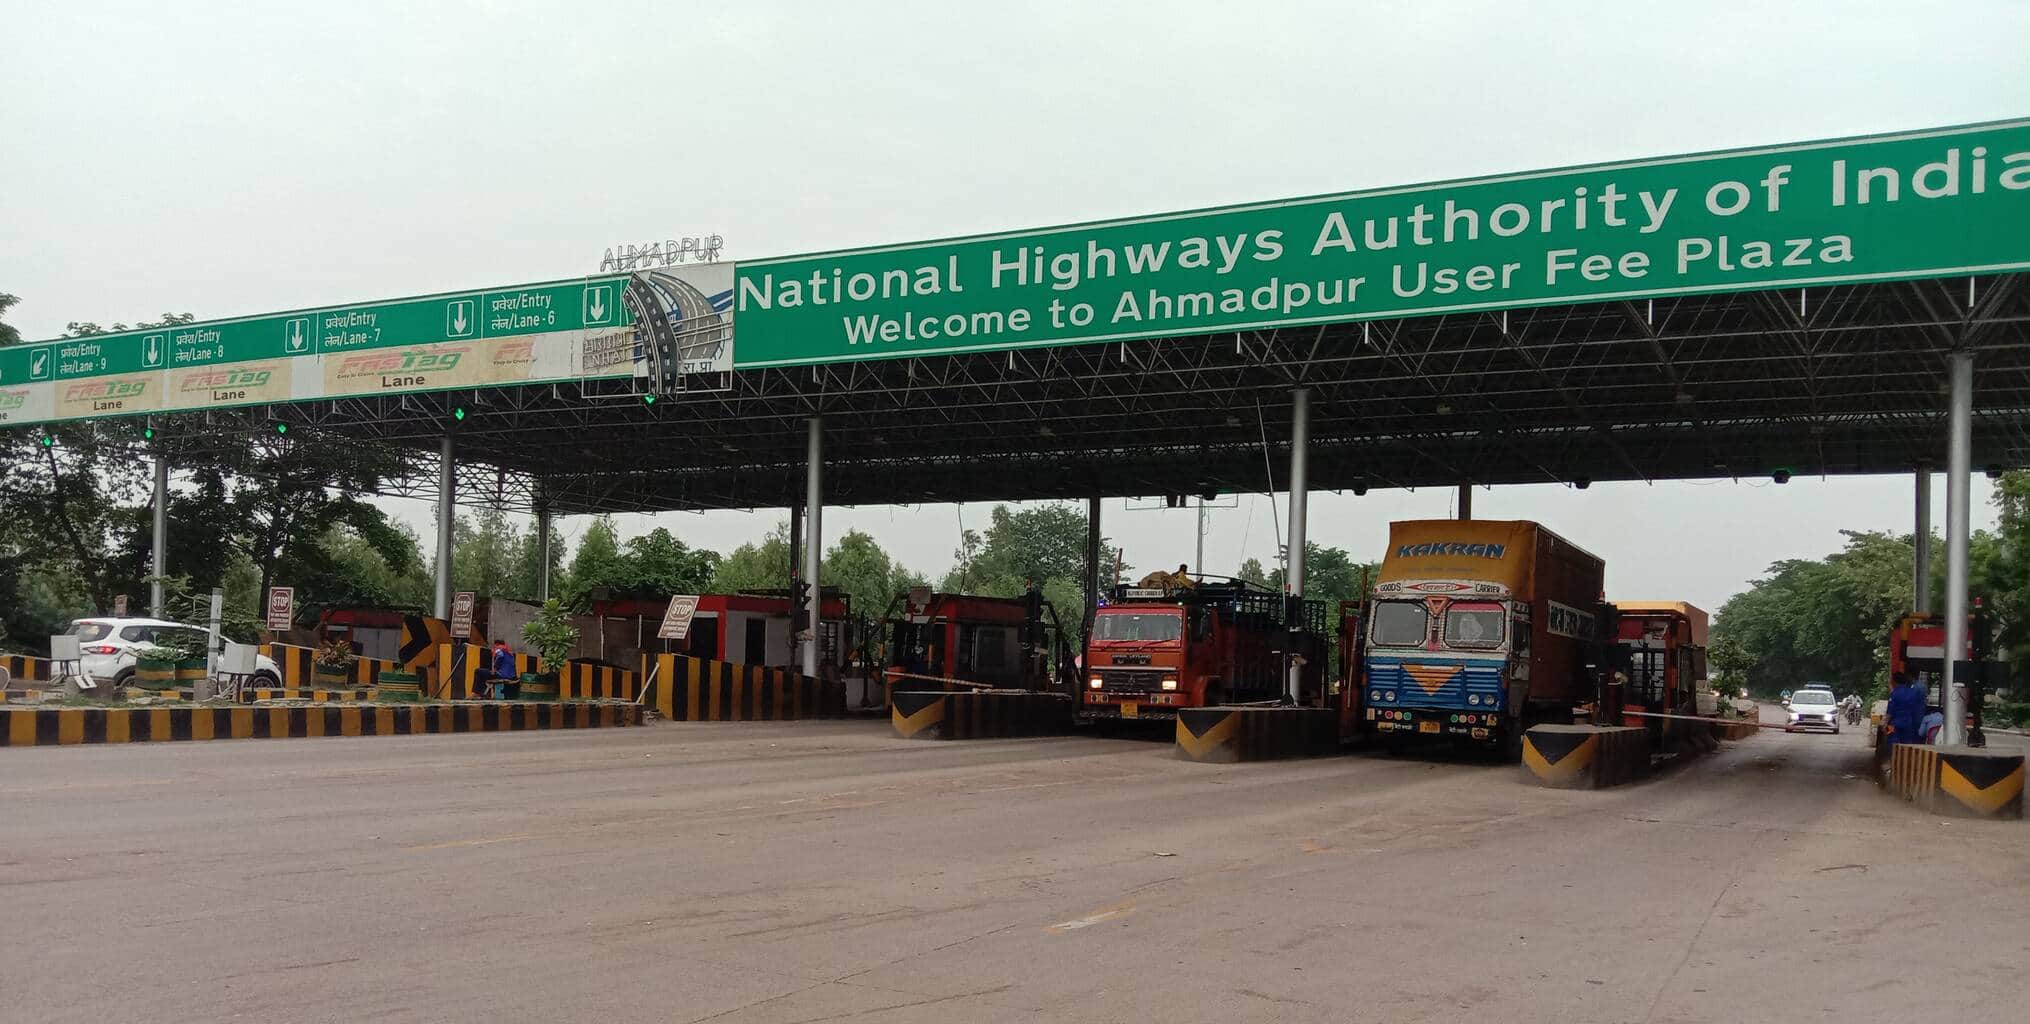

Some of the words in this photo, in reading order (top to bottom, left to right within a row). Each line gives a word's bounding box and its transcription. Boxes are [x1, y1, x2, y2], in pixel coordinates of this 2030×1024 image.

[739, 255, 963, 312] National
[991, 230, 1285, 291] Highways
[1311, 183, 1678, 256] Authority
[1705, 164, 1792, 216] of
[1832, 146, 2030, 206] India
[601, 234, 724, 272] AHMADPUR
[843, 309, 1031, 346] Welcome
[1048, 298, 1094, 329] to
[1111, 276, 1366, 323] Ahmadpur
[1392, 257, 1521, 299] User
[1546, 248, 1650, 285] Fee
[1677, 234, 1854, 275] Plaza
[492, 292, 551, 312] प्रवेश/Entry
[548, 310, 555, 325] 6
[374, 328, 381, 342] 7
[218, 345, 224, 358] 8
[101, 358, 107, 370] 9
[382, 375, 425, 388] Lane
[213, 390, 246, 401] Lane
[93, 400, 123, 411] Lane
[1397, 542, 1506, 559] KAKRAN
[1380, 582, 1402, 592] GOODS
[273, 596, 288, 607] STOP
[456, 600, 471, 611] STOP
[673, 604, 693, 616] STOP
